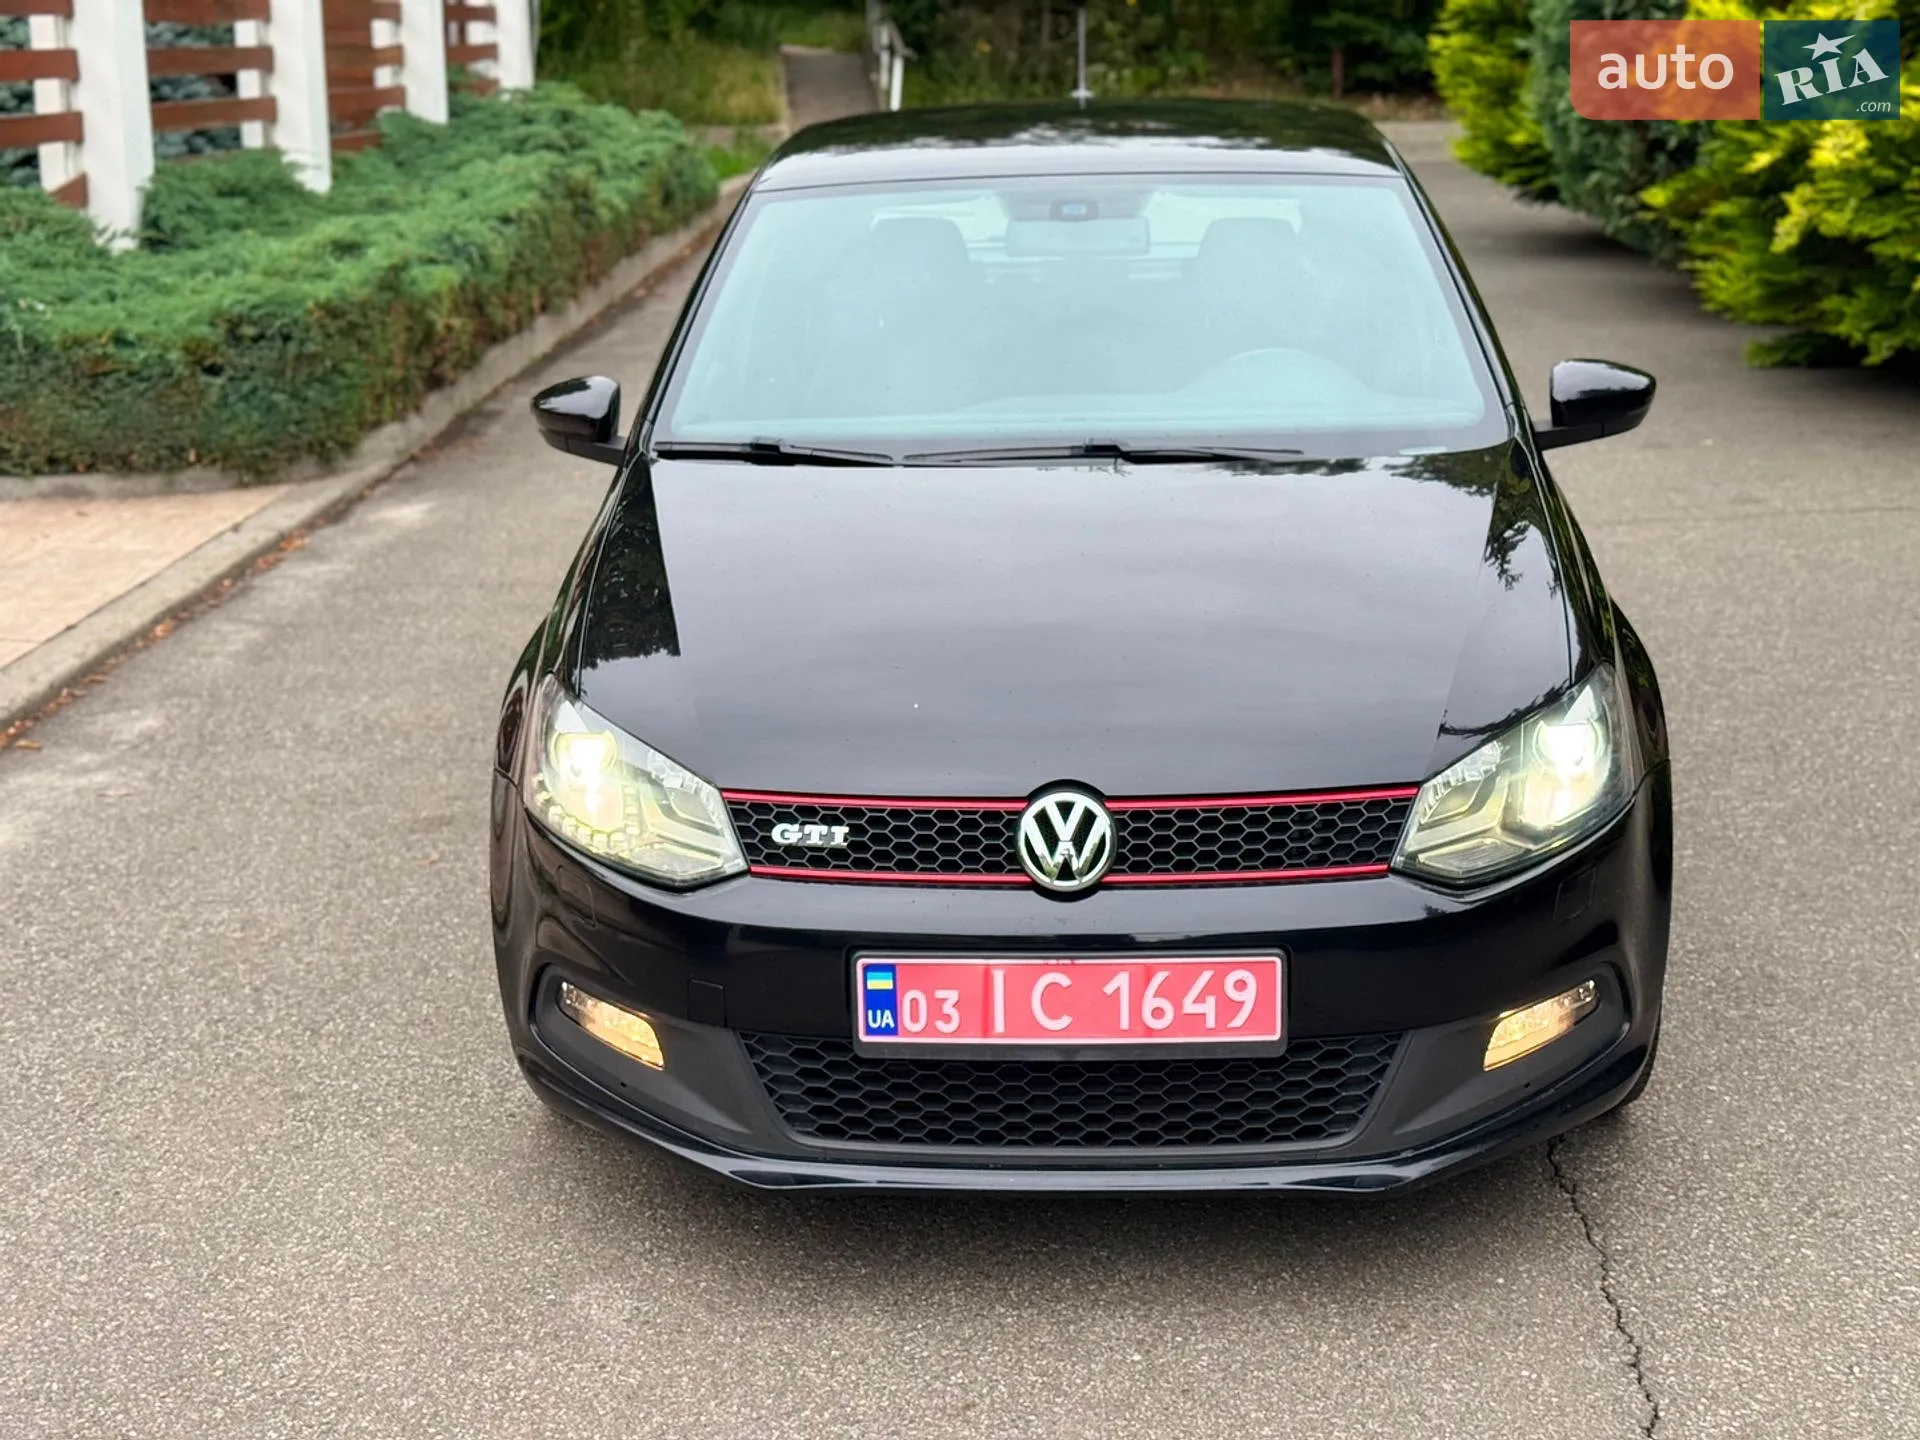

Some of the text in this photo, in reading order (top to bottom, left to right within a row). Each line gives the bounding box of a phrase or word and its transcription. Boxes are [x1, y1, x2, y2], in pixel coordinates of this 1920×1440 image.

[771, 823, 849, 848] GTI
[902, 990, 960, 1034] 03
[1102, 969, 1258, 1030] 1649
[868, 1009, 895, 1028] UA
